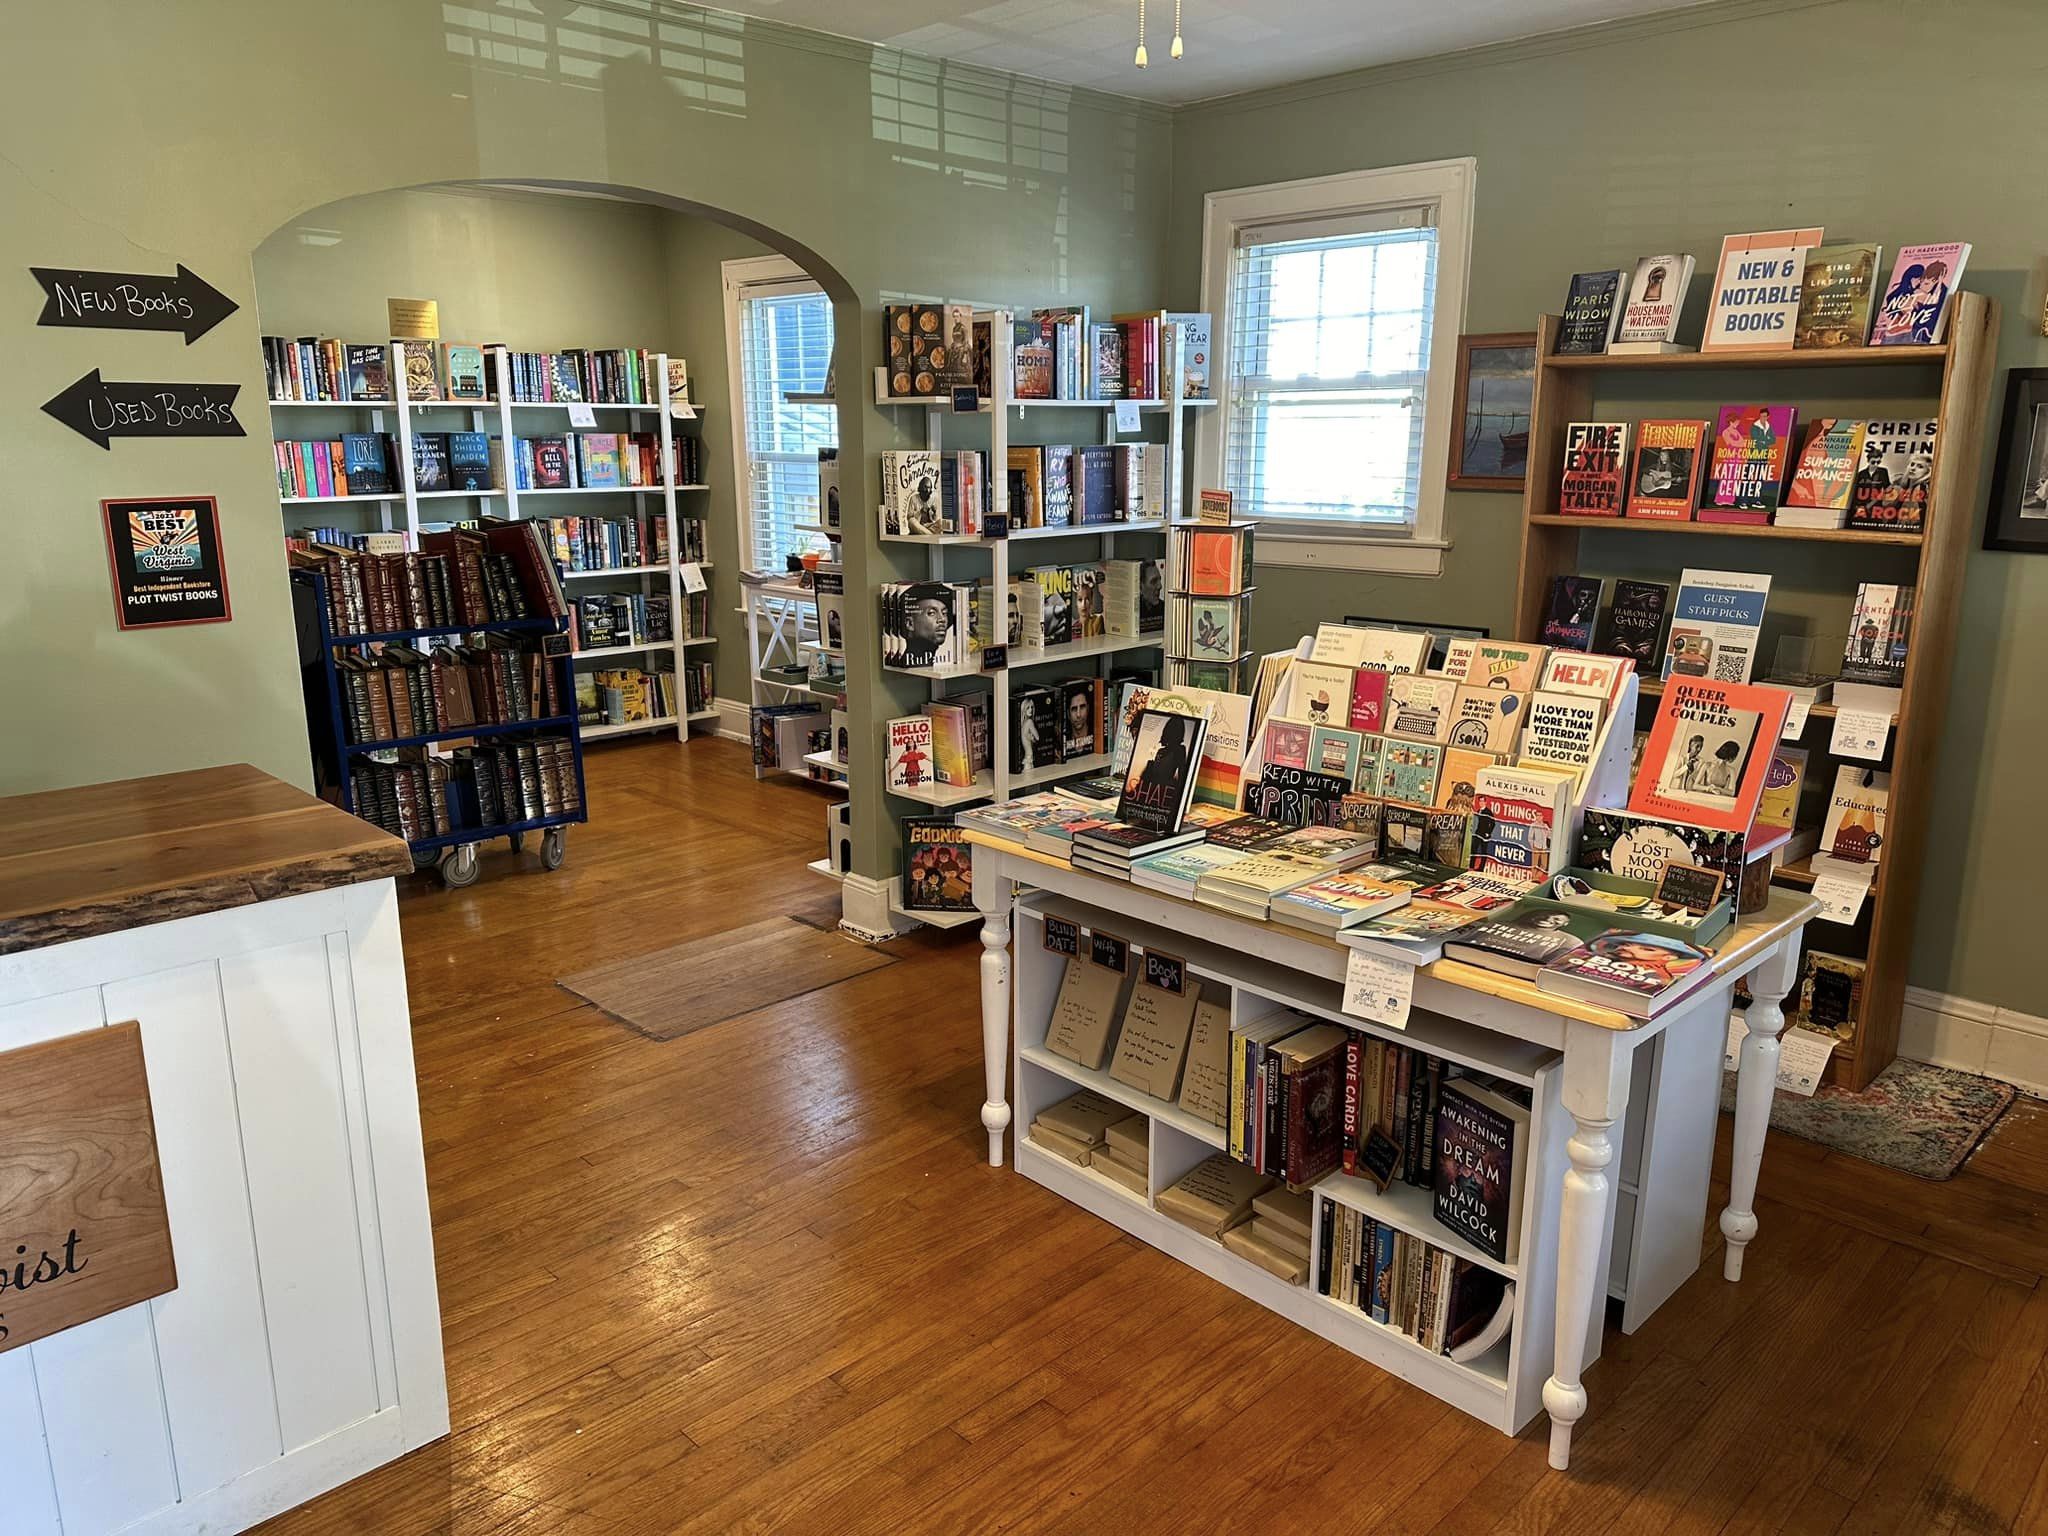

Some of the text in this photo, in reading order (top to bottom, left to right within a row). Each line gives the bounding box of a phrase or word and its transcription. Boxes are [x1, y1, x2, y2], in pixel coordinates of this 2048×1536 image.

[1915, 244, 1960, 254] HAZELWOOD
[1737, 259, 1794, 281] NEW &
[1826, 264, 1851, 272] SING
[1838, 276, 1864, 285] FISH
[1573, 293, 1611, 306] PARIS
[1719, 285, 1801, 307] NOTABLE
[1886, 292, 1941, 312] NOT IN
[1564, 307, 1611, 321] WIDOW
[1627, 304, 1672, 317] HOUSEMAID
[1888, 306, 1936, 330] LOVE
[1567, 326, 1602, 334] KIMBERLY
[1629, 316, 1670, 328] WATCHING
[1725, 312, 1785, 332] BOOKS
[1867, 422, 1937, 436] CHRIS
[1569, 426, 1622, 450] FIRE
[1744, 439, 1757, 449] THE
[352, 441, 375, 462] LORE
[415, 443, 439, 451] SARAH
[1717, 448, 1777, 460] ROM-COMMERS
[1811, 443, 1857, 451] MONAGHAN
[1864, 441, 1934, 455] STEIN
[454, 453, 486, 461] MAIDEN
[1567, 451, 1620, 473] EXIT
[1803, 456, 1853, 470] SUMMER
[1714, 464, 1774, 481] KATHERINE
[1796, 470, 1852, 482] ROMANCE
[1563, 480, 1617, 492] MORGAN
[1719, 481, 1762, 498] CENTER
[1563, 492, 1616, 509] TALTY
[1857, 487, 1925, 503] UNDER
[1854, 506, 1921, 520] A ROCK
[143, 518, 186, 532] BEST
[152, 545, 186, 557] West
[143, 556, 194, 570] Virginia
[133, 581, 211, 593] Best Independent Bookstore
[1039, 568, 1072, 594] KING
[127, 590, 218, 605] PLOT TWIST BOOKS
[1703, 593, 1737, 605] GUEST
[1688, 605, 1750, 620] STAFF PICKS
[1615, 616, 1656, 629] GAMES
[905, 650, 951, 666] RuPaul
[1481, 647, 1499, 659] YOU
[1448, 658, 1467, 667] FOR
[1846, 656, 1905, 668] AMOR TOWLES
[1551, 664, 1609, 689] HELP!
[1677, 685, 1726, 702] QUEER
[1464, 697, 1496, 708] DON'T YOU
[1473, 705, 1495, 714] DYING
[1674, 697, 1730, 715] POWER
[1535, 703, 1594, 720] I LOVE YOU
[1670, 708, 1737, 728] COUPLES
[893, 722, 931, 737] HELLO,
[1533, 714, 1593, 731] MORE THAN
[893, 733, 931, 747] MOLLY!
[1533, 724, 1590, 742] YESTERDAY.
[1528, 745, 1590, 764] YOU GOT ON
[900, 770, 925, 779] MOLLY
[1263, 764, 1341, 793] READ WITH
[1125, 778, 1177, 809] SHAE
[1485, 778, 1547, 797] ALEXIS HALL
[1649, 786, 1668, 794] LOVE
[1262, 786, 1341, 828] PRIDE
[1341, 800, 1378, 821] SCREAM
[1490, 801, 1537, 822] 10 THINGS
[1645, 799, 1691, 813] POSSIBILITY
[1386, 809, 1410, 822] SCREAM
[1431, 815, 1464, 831] CREAM
[910, 827, 966, 843] GOONIE
[1500, 825, 1523, 841] THAT
[1494, 844, 1526, 862] NEVER
[1633, 842, 1673, 858] LOST
[1628, 855, 1664, 870] MOO
[1484, 863, 1533, 882] HAPPENED
[1309, 880, 1394, 900] BUMP
[1048, 919, 1078, 938] BLIND
[1478, 926, 1537, 944] BETWEEN
[1492, 923, 1517, 934] THE
[1047, 934, 1077, 952] DATE
[1148, 957, 1180, 985] Book
[1568, 957, 1664, 987] GEORGE
[1590, 955, 1656, 977] BOY
[1344, 1045, 1357, 1132] LOVE CARDS
[1441, 1090, 1464, 1107] CONTACT
[1440, 1105, 1507, 1150] AWAKENING
[1458, 1131, 1486, 1154] IN THE
[1443, 1138, 1500, 1186] DREAM
[1449, 1184, 1488, 1218] DAVID
[1439, 1194, 1497, 1244] WILCOCK
